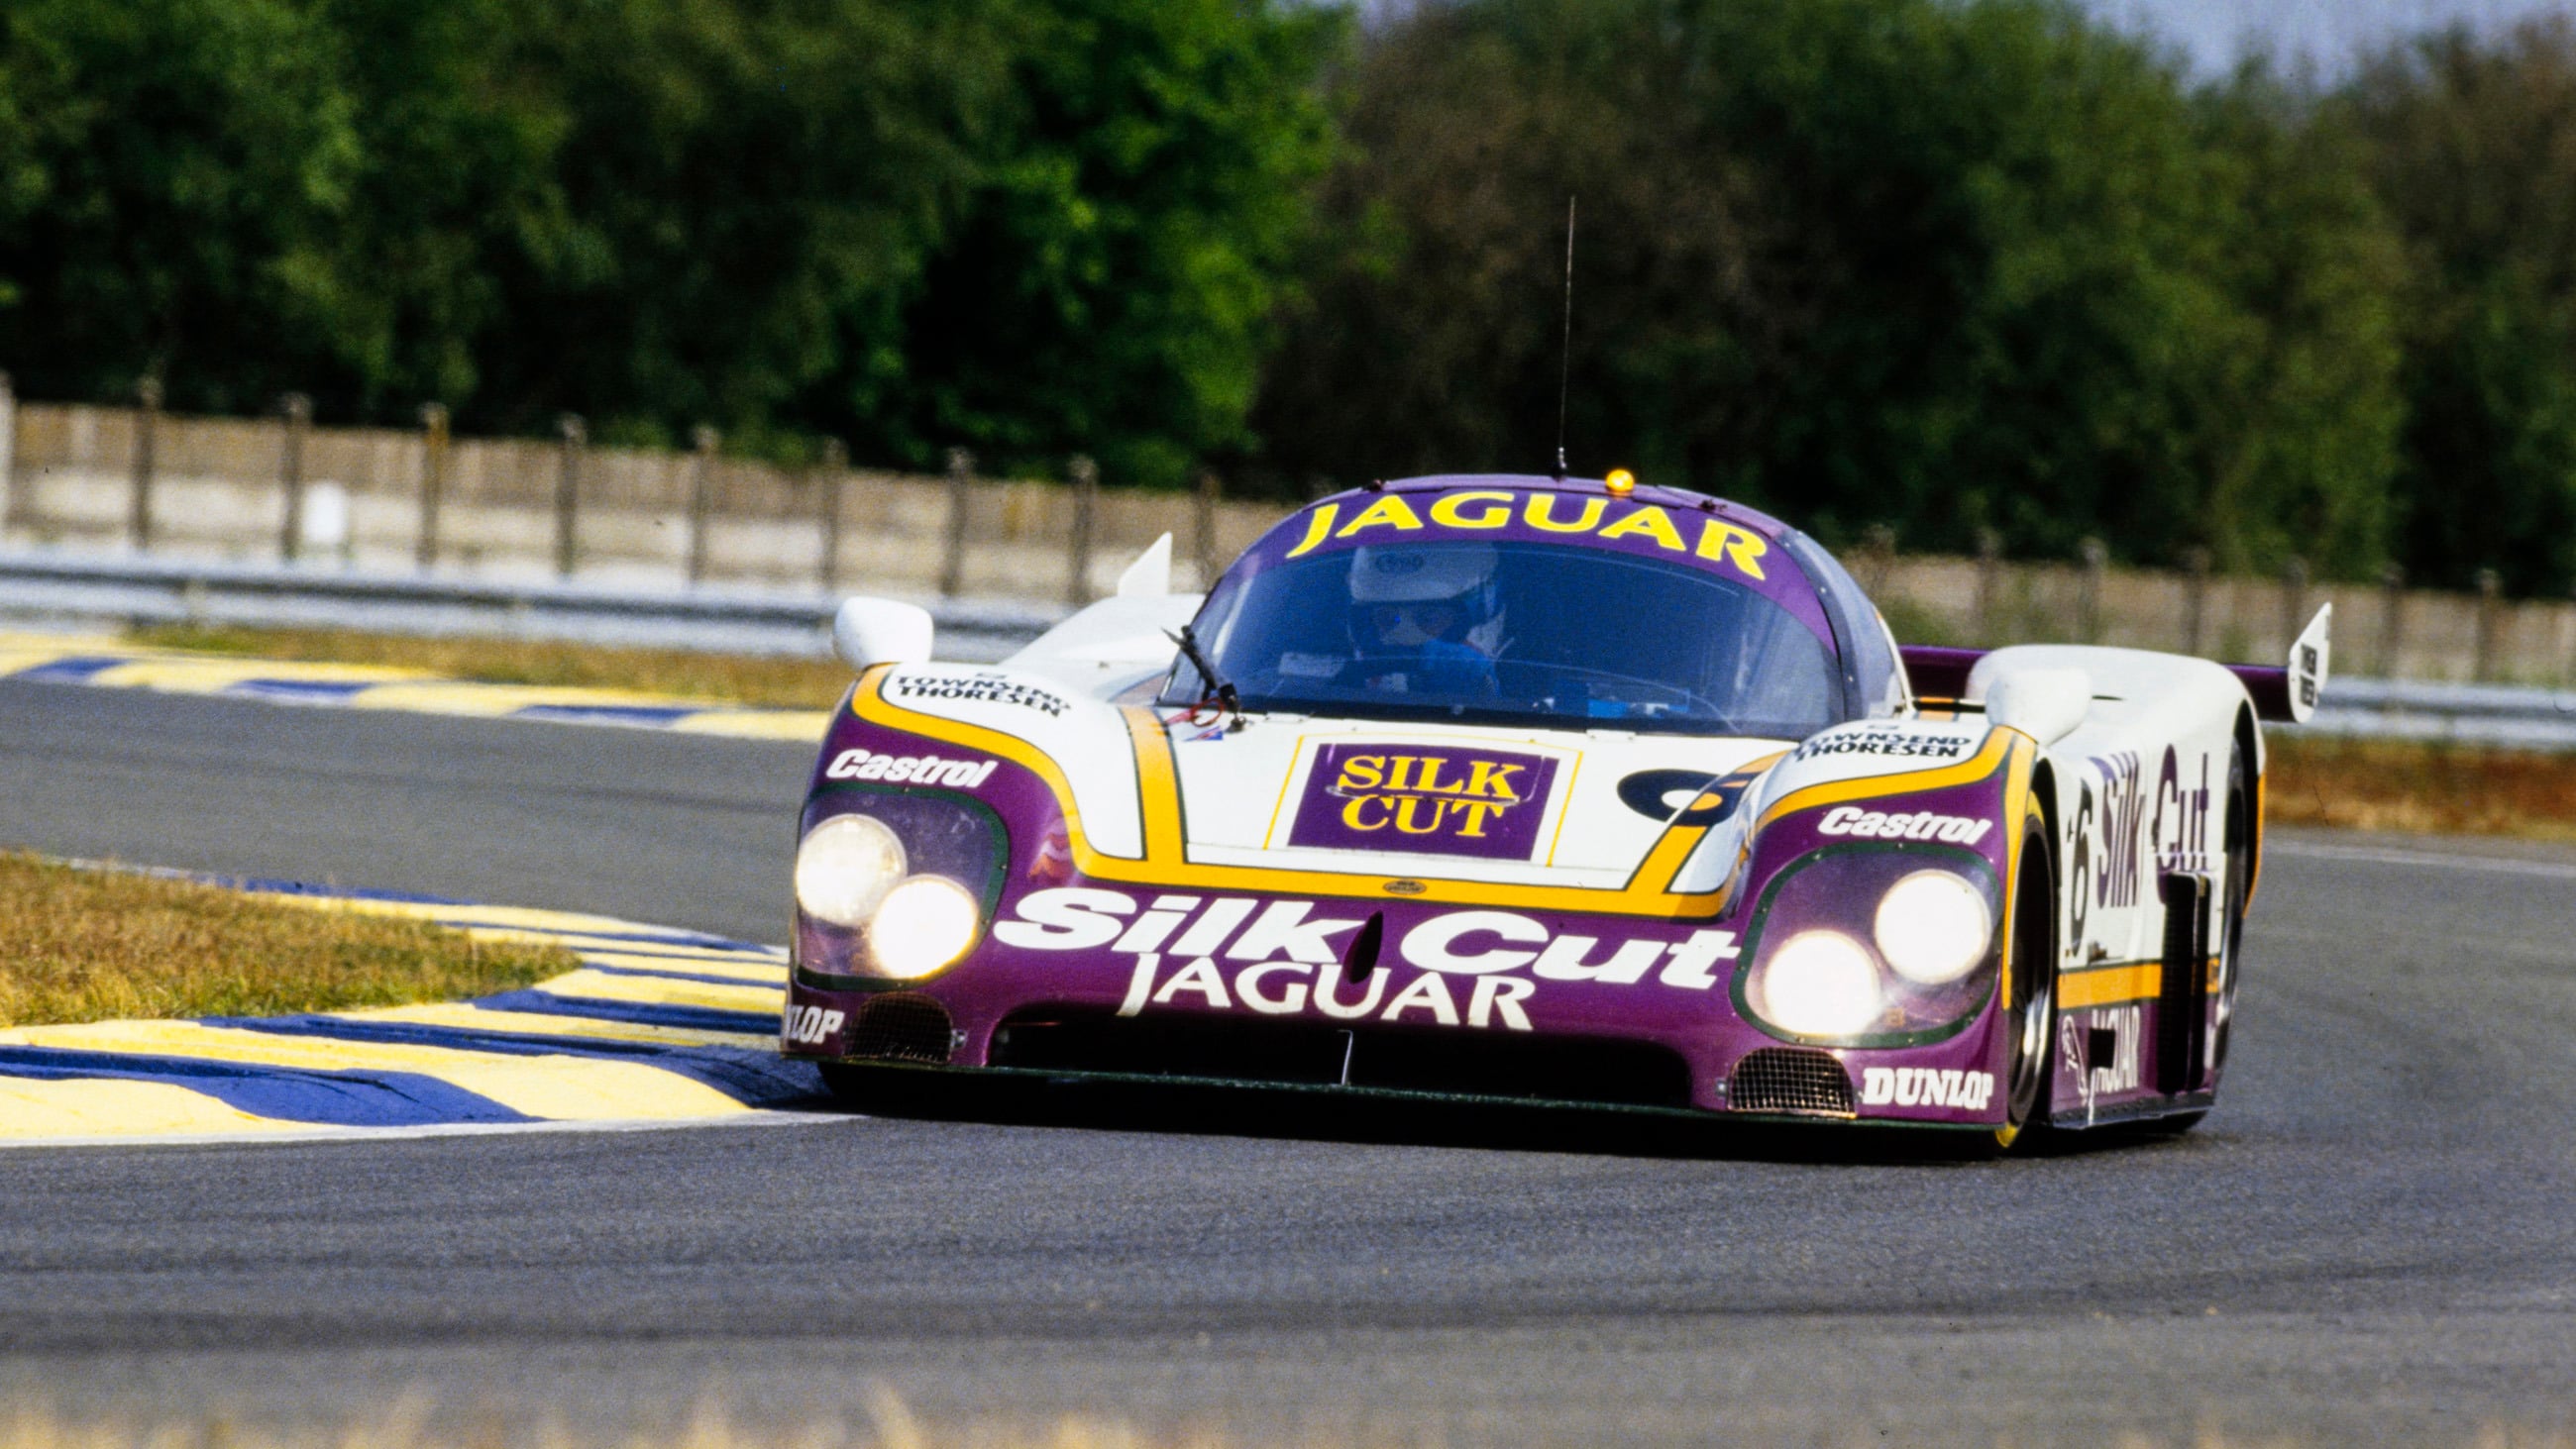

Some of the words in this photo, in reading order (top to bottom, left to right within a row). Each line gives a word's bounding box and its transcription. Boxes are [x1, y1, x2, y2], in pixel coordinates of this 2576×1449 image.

[1286, 491, 1768, 580] JAGUAR
[898, 675, 1071, 709] TOWNSEND
[900, 686, 1061, 717] THORESEN
[1796, 733, 1971, 754] TOWNSEND
[1796, 743, 1960, 762] THORESEN
[825, 749, 999, 788] Castrol
[1337, 755, 1526, 799] SILK
[1342, 794, 1507, 837] CUT
[1817, 805, 1992, 846] Castrol
[2087, 751, 2146, 909] Silk
[2155, 744, 2208, 904] Cut
[2071, 777, 2093, 957] 6
[993, 887, 1366, 964] Silk
[1400, 911, 1741, 989] Cut
[1116, 953, 1535, 1030] JAGUAR
[1862, 1067, 1993, 1110] DUNLOP
